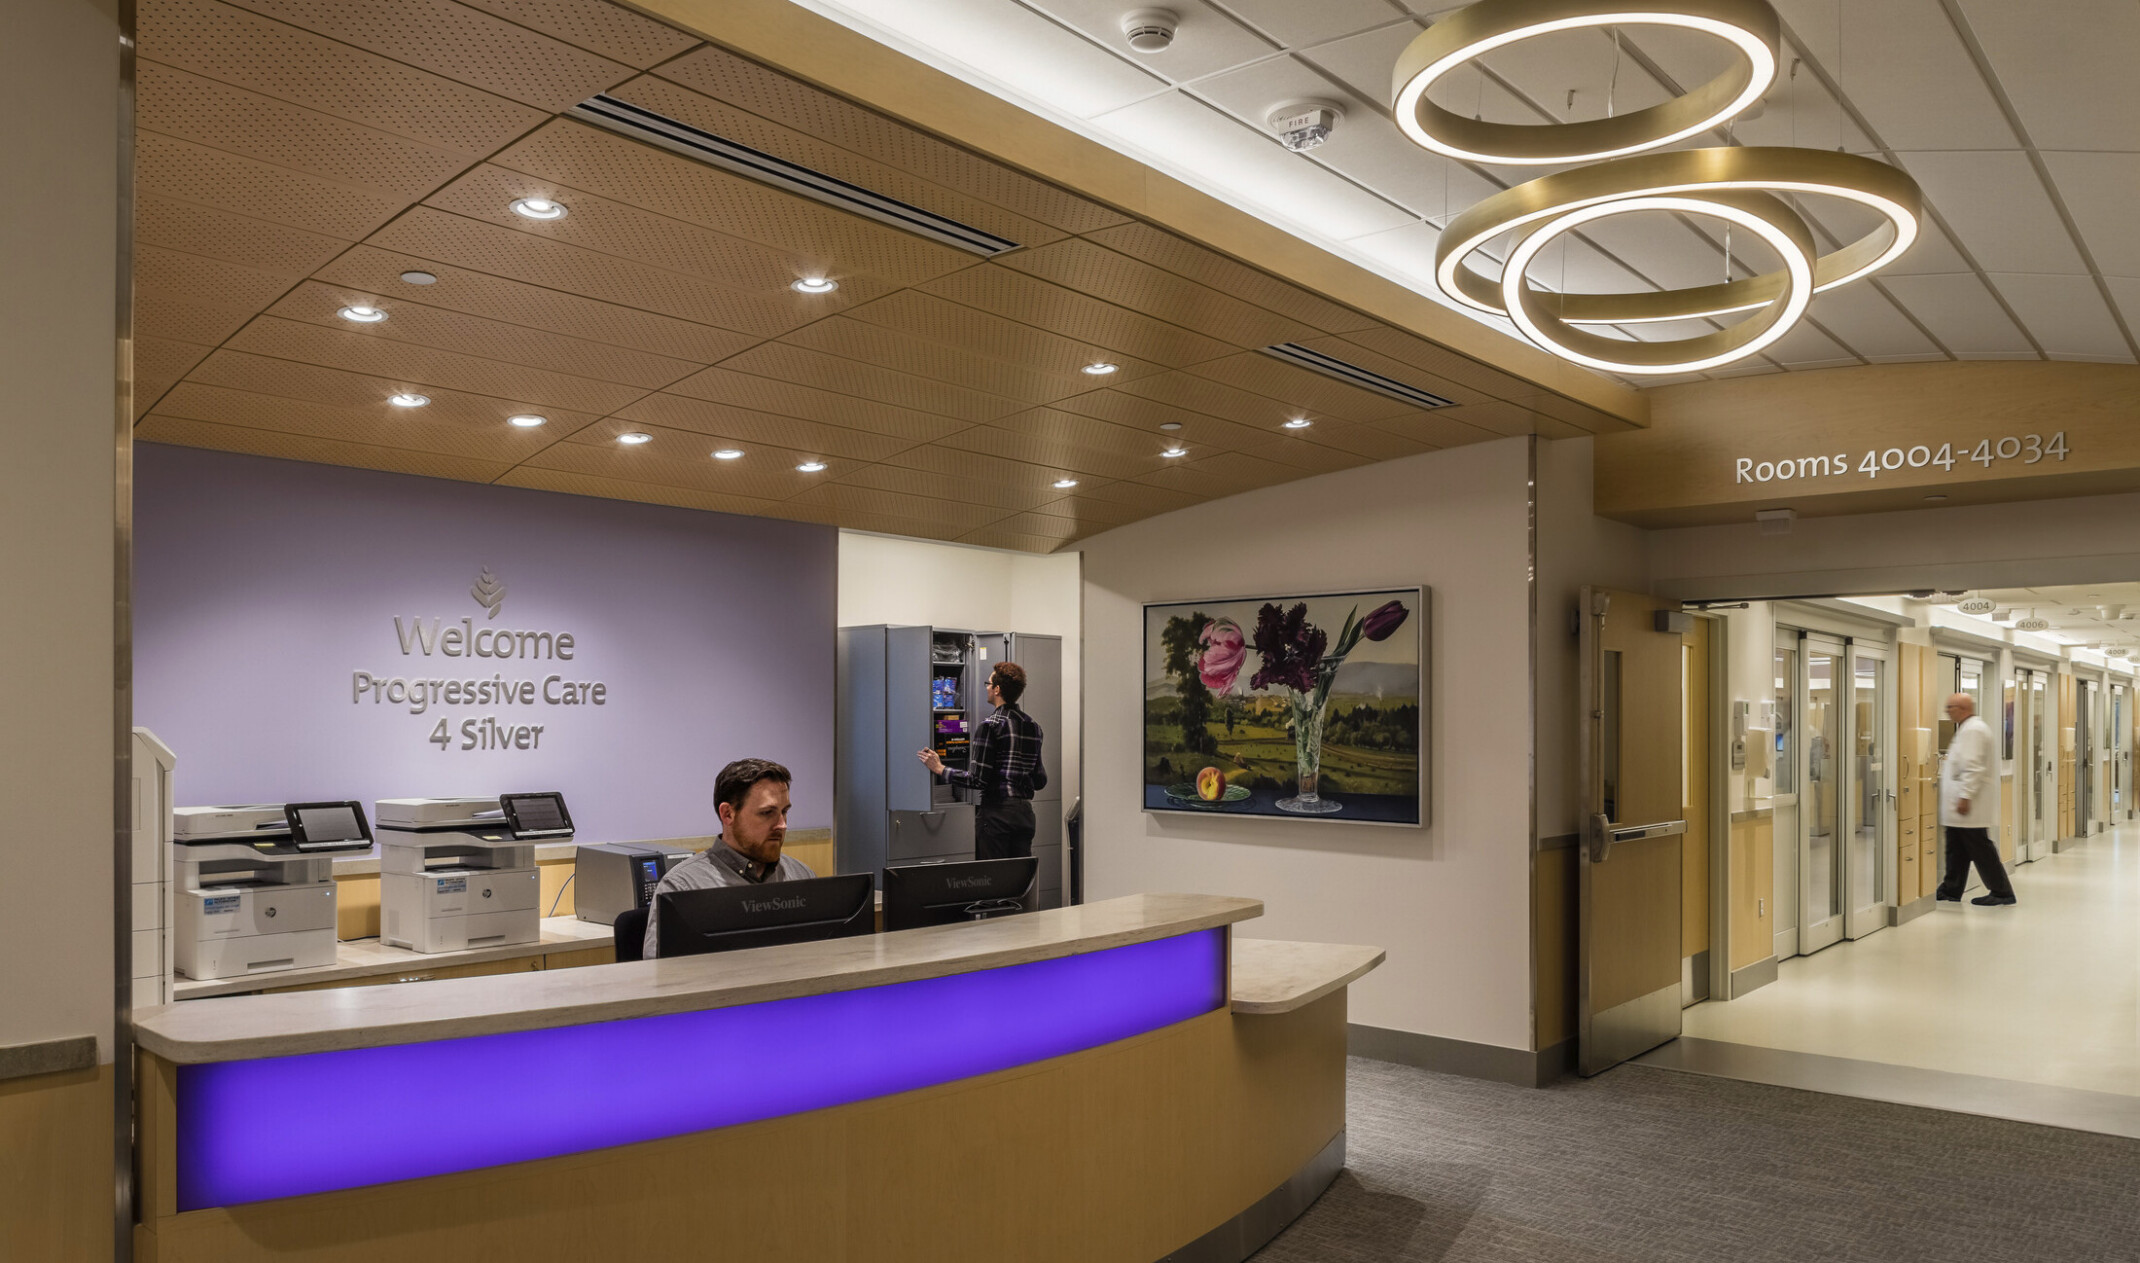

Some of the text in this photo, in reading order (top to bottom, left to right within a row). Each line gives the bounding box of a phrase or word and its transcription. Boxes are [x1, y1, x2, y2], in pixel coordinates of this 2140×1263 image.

[1289, 117, 1309, 128] FIRE
[1736, 431, 2070, 484] Rooms 4004-4034
[1963, 602, 1990, 611] 4004
[2020, 621, 2044, 629] 4006
[394, 615, 575, 660] Welcome
[353, 671, 607, 714] Progressive Care
[429, 716, 544, 751] 4 Silver
[946, 875, 992, 890] ViewSonic
[742, 896, 807, 913] ViewSonic
